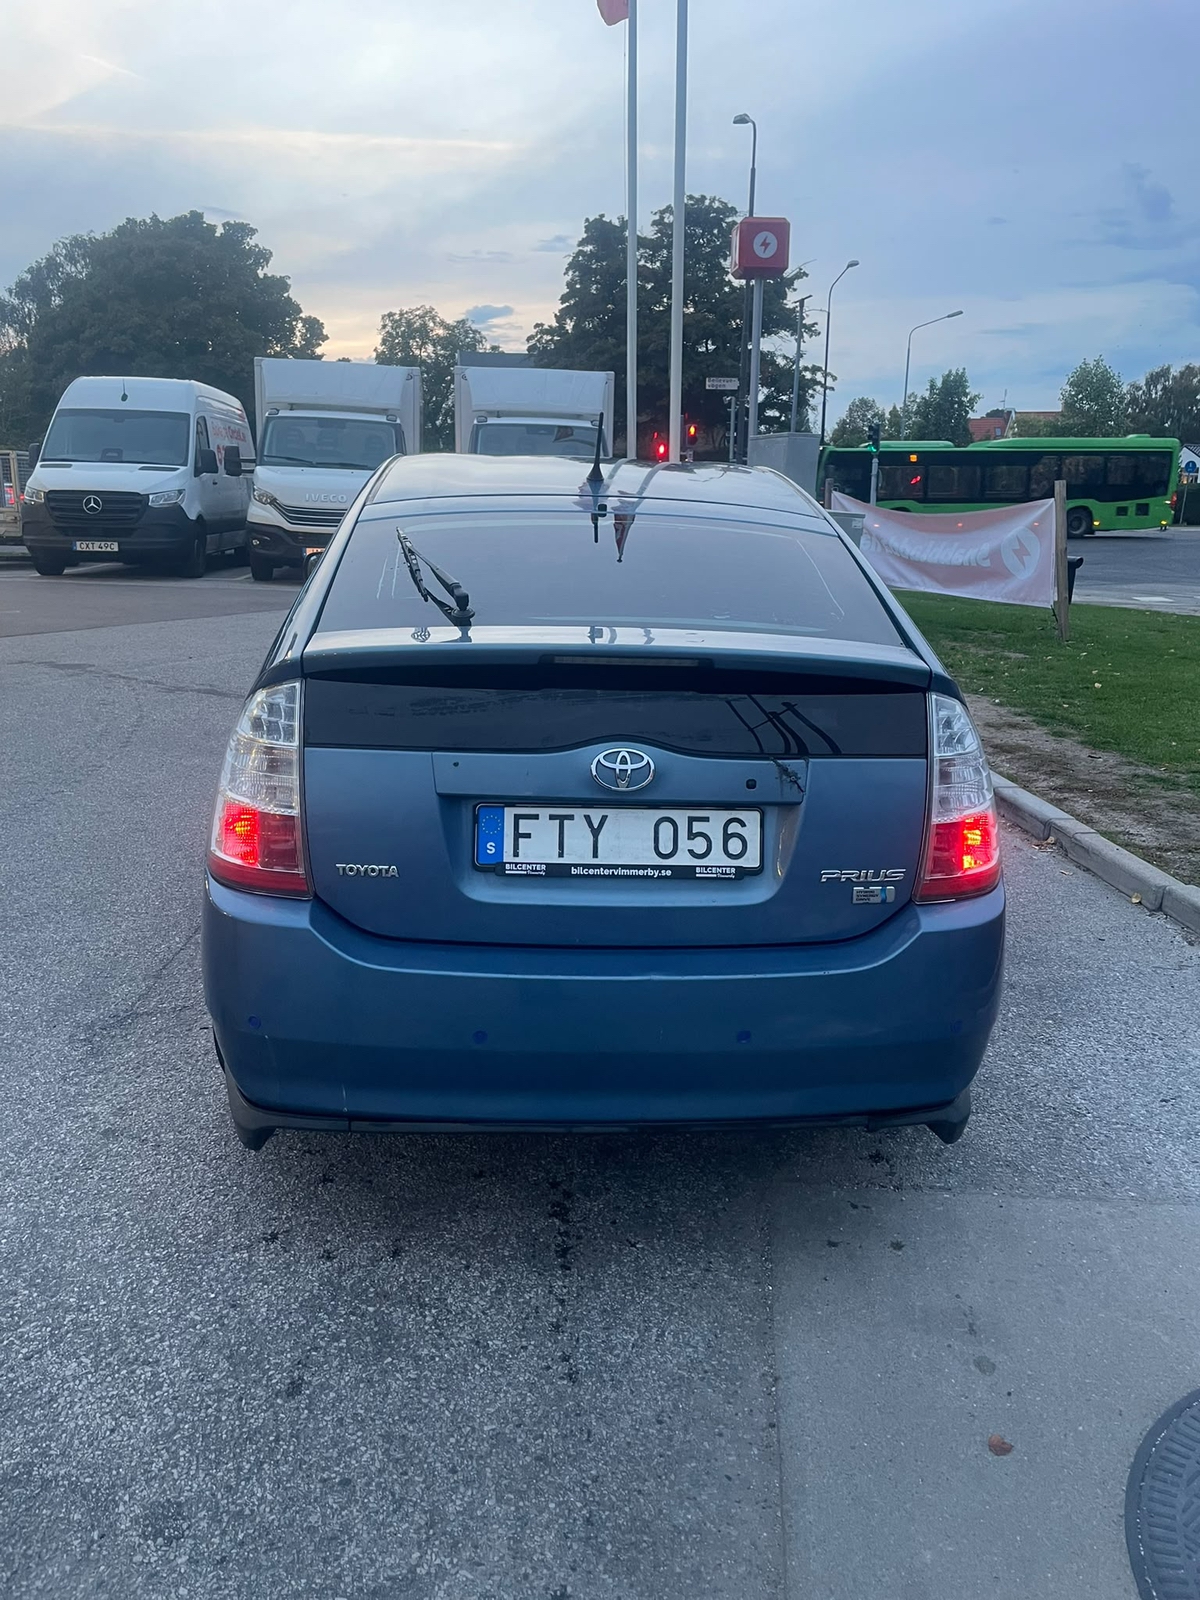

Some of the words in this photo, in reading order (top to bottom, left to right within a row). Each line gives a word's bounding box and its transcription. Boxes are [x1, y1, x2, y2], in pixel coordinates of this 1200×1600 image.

[305, 493, 347, 503] IVECO
[79, 542, 95, 550] CXT
[98, 542, 115, 551] 49C
[512, 813, 609, 859] FTY
[653, 815, 748, 860] 056
[486, 842, 496, 854] S
[335, 863, 399, 878] TOYOTA
[505, 863, 546, 871] BILCENTER
[571, 866, 672, 878] bilcentervimmerby.se
[695, 866, 736, 874] BILCENTER
[820, 868, 907, 882] PRIUS
